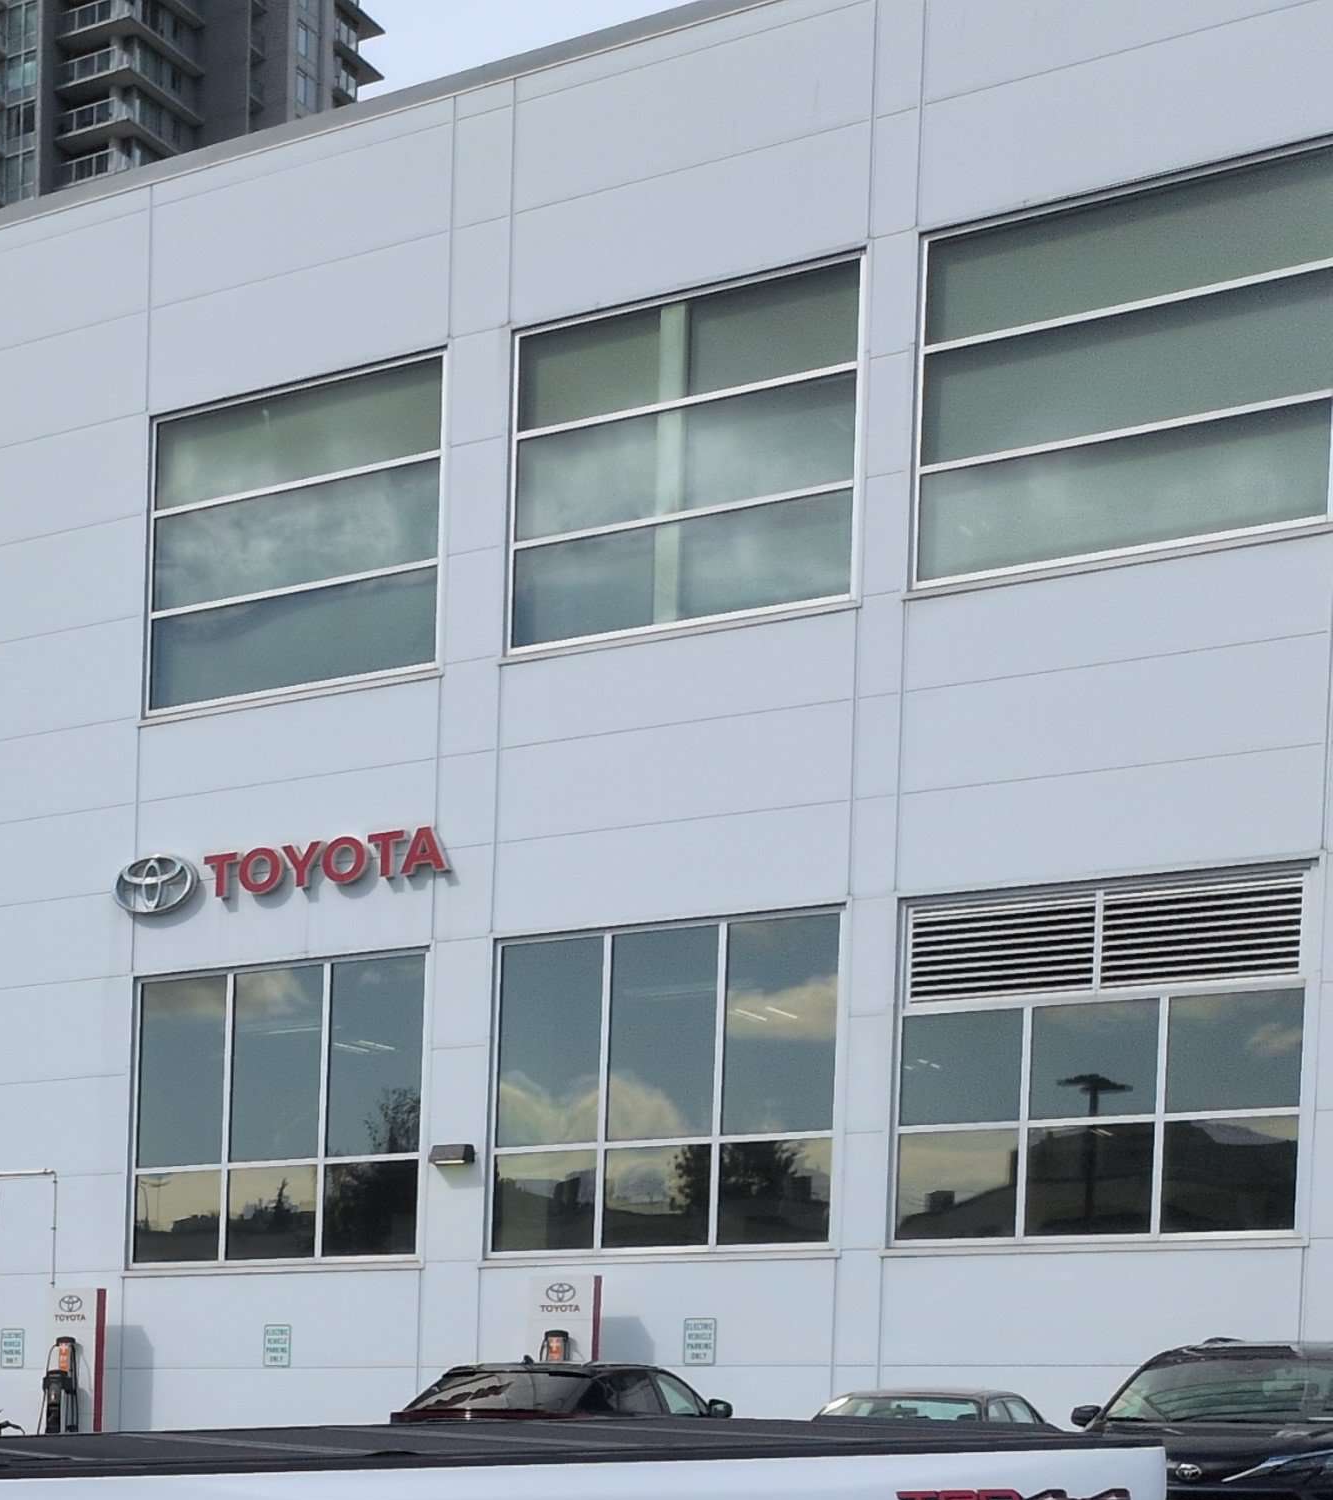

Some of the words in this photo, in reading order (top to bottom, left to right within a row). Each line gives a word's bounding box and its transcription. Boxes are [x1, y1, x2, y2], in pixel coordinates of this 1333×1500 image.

[204, 826, 451, 899] TOYOTA
[540, 1304, 580, 1313] TOYOTA
[54, 1314, 86, 1322] TOYOTA
